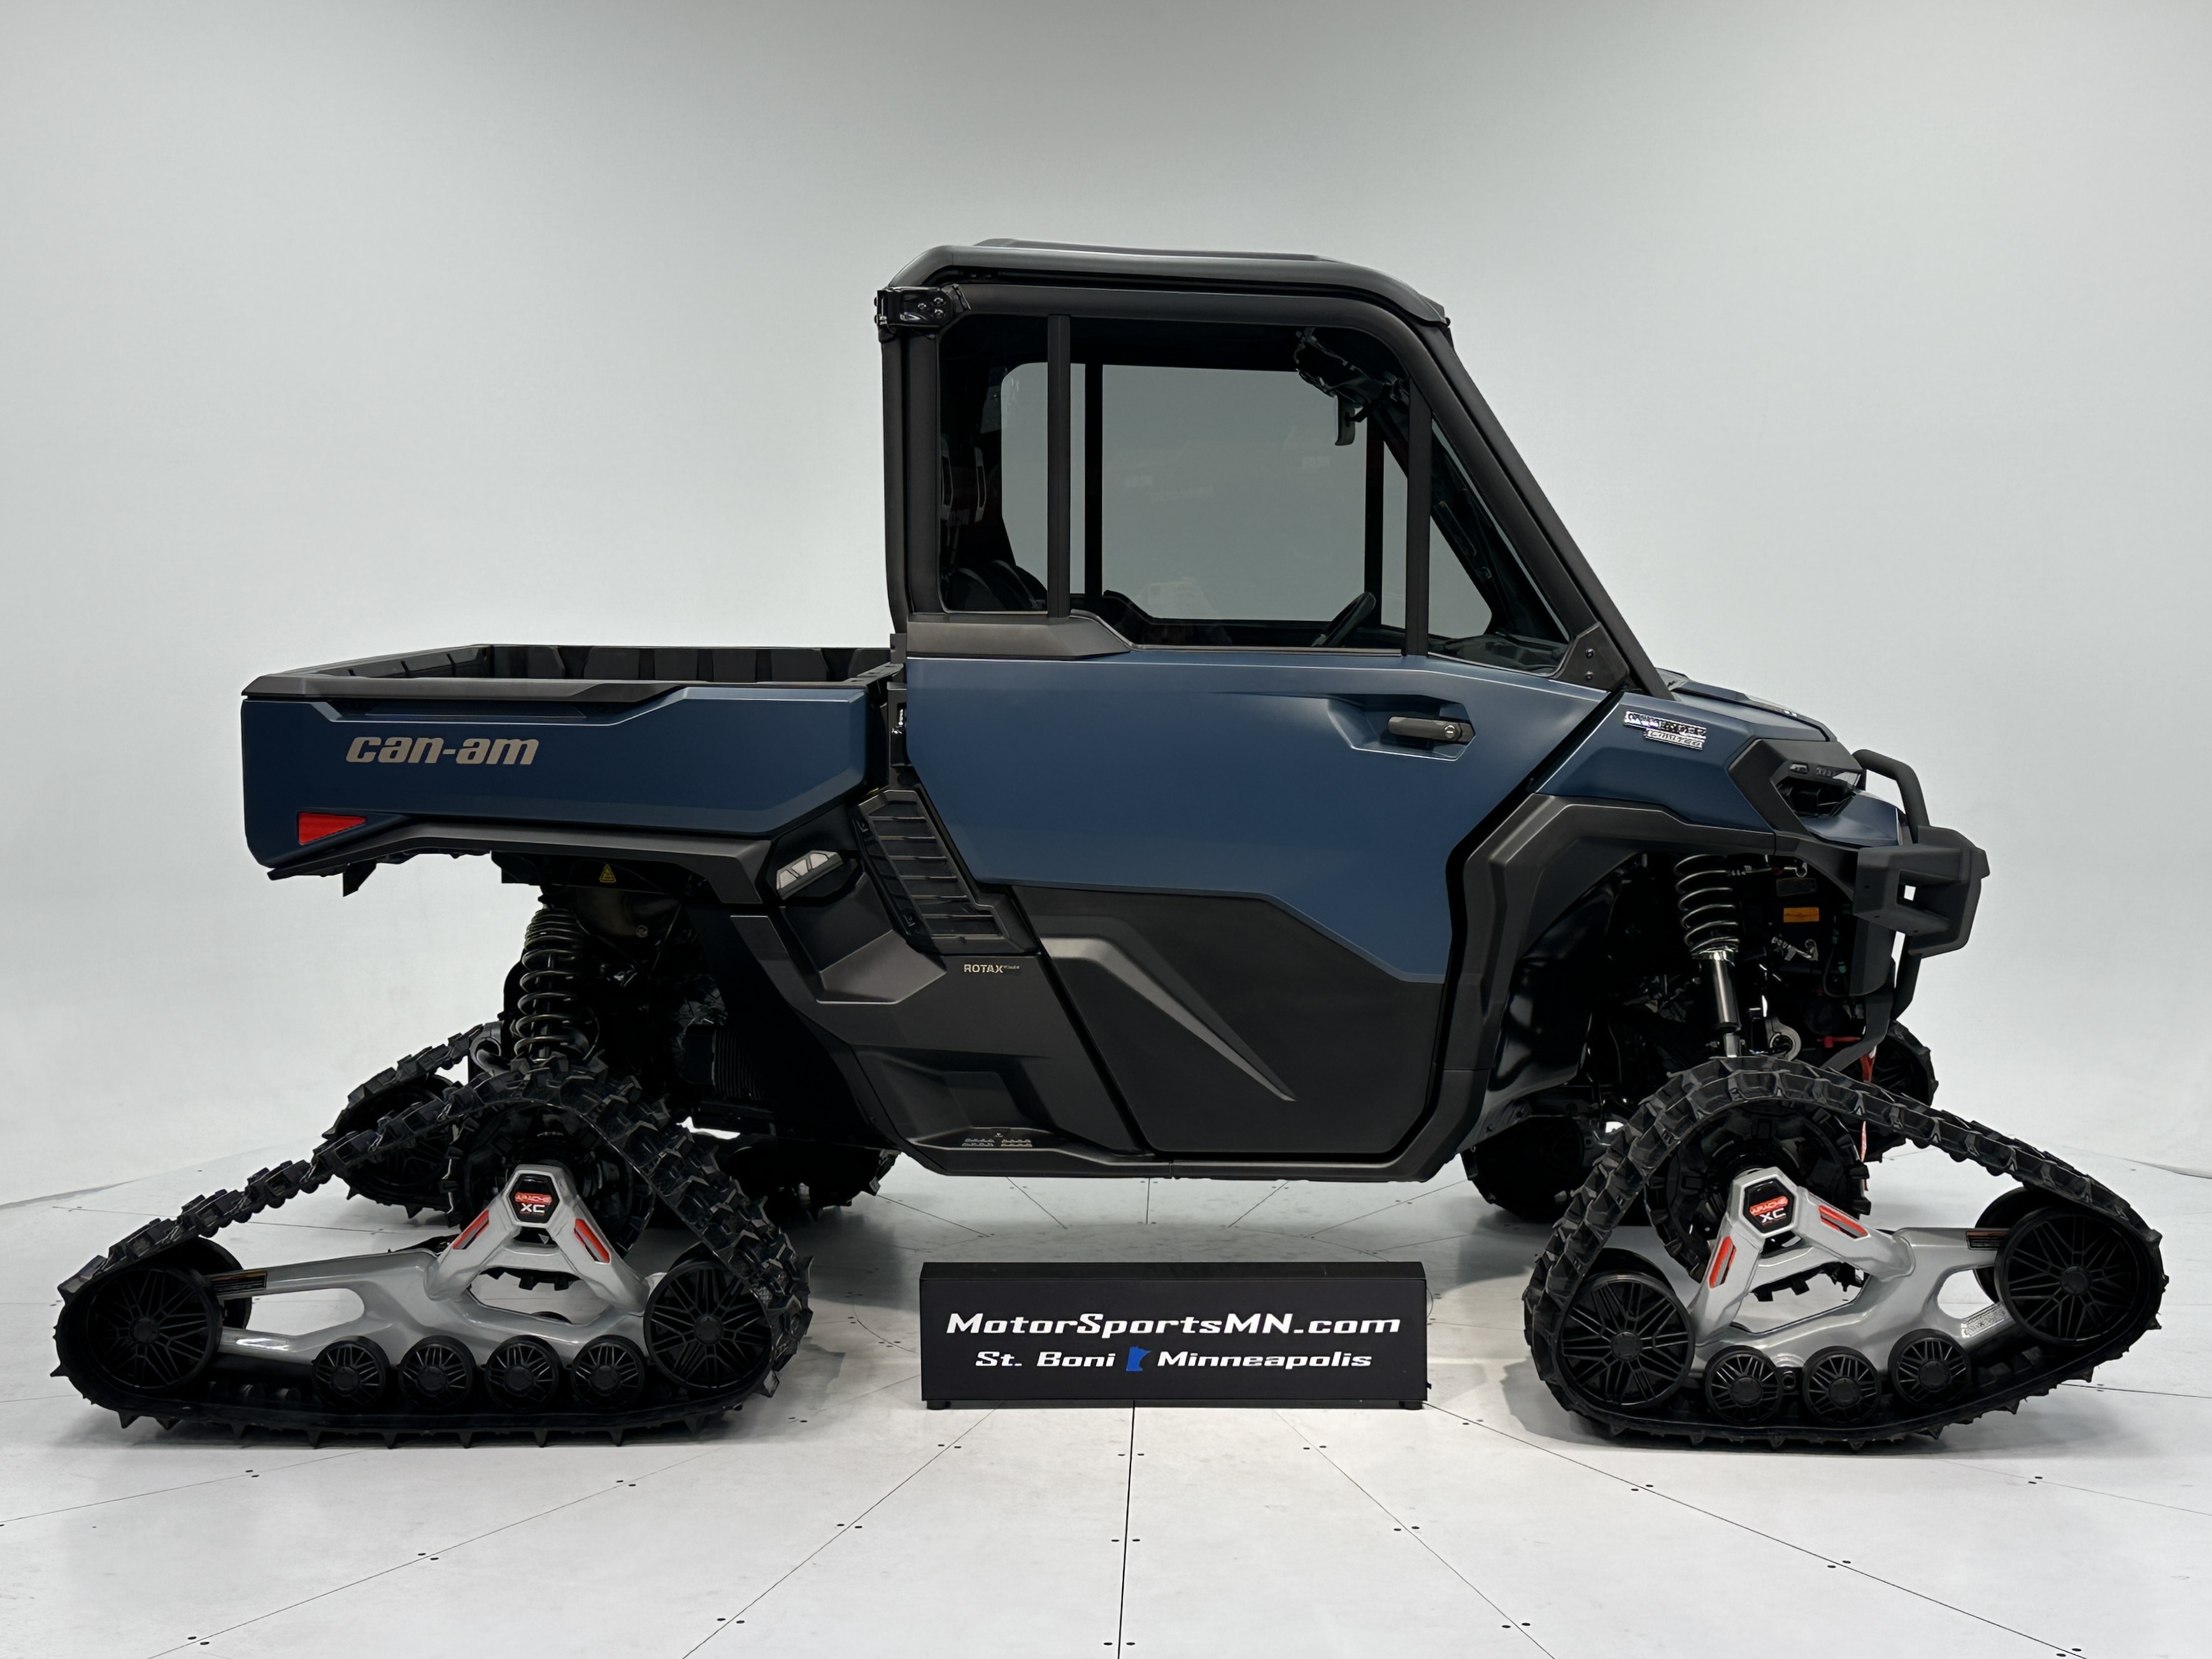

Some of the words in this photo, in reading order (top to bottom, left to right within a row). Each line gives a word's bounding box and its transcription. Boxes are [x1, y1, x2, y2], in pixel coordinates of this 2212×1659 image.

[346, 737, 539, 765] can-am
[964, 964, 1003, 973] ROTAX
[520, 1202, 546, 1213] XC
[1759, 1207, 1786, 1223] XC
[946, 1313, 1401, 1339] MotorSportsMN.com
[975, 1351, 1022, 1367] St.
[1036, 1351, 1116, 1367] Boni
[1157, 1351, 1372, 1370] Minneapolis
